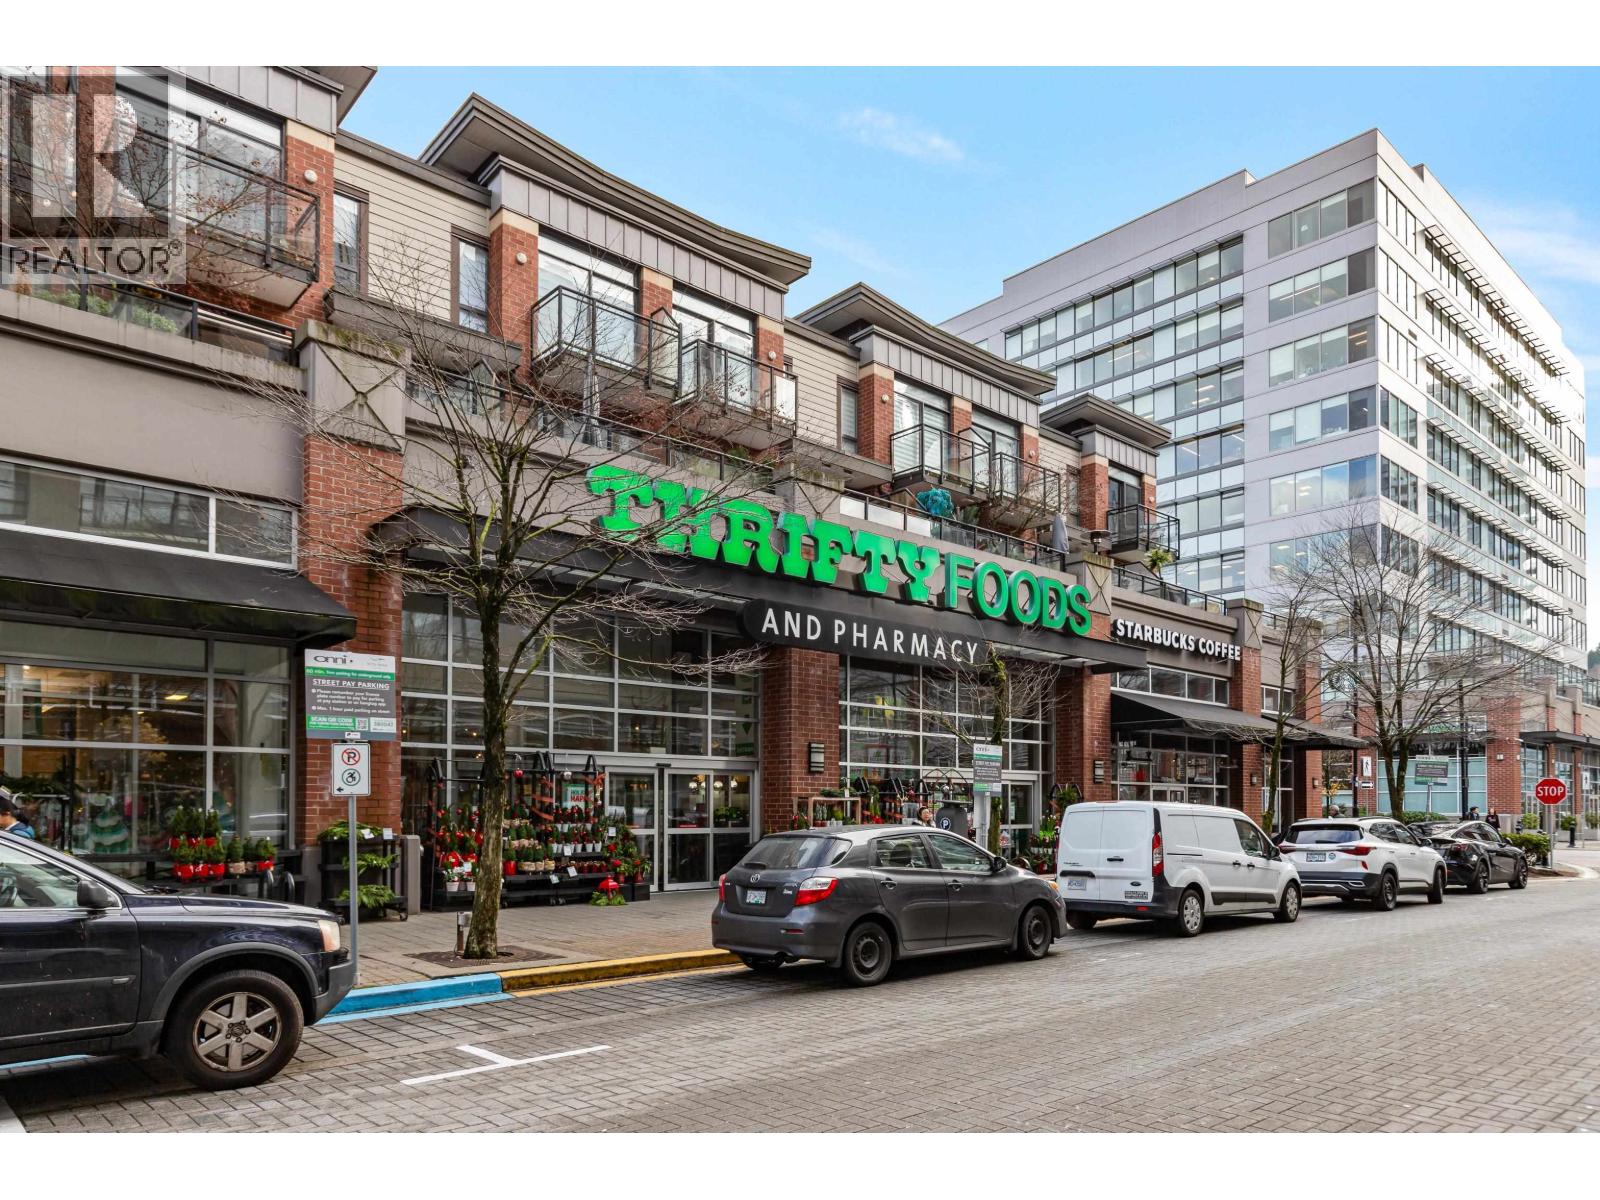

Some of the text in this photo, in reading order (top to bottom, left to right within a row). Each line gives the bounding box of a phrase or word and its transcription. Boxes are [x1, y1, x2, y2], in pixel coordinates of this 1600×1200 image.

[585, 465, 1093, 637] THRIFTY FOODS
[761, 608, 979, 665] AND PHARMACY
[1116, 619, 1241, 661] STARBUCKS COFFEE
[312, 678, 341, 687] STREET
[358, 682, 390, 690] PARKING
[1537, 786, 1564, 797] STOP
